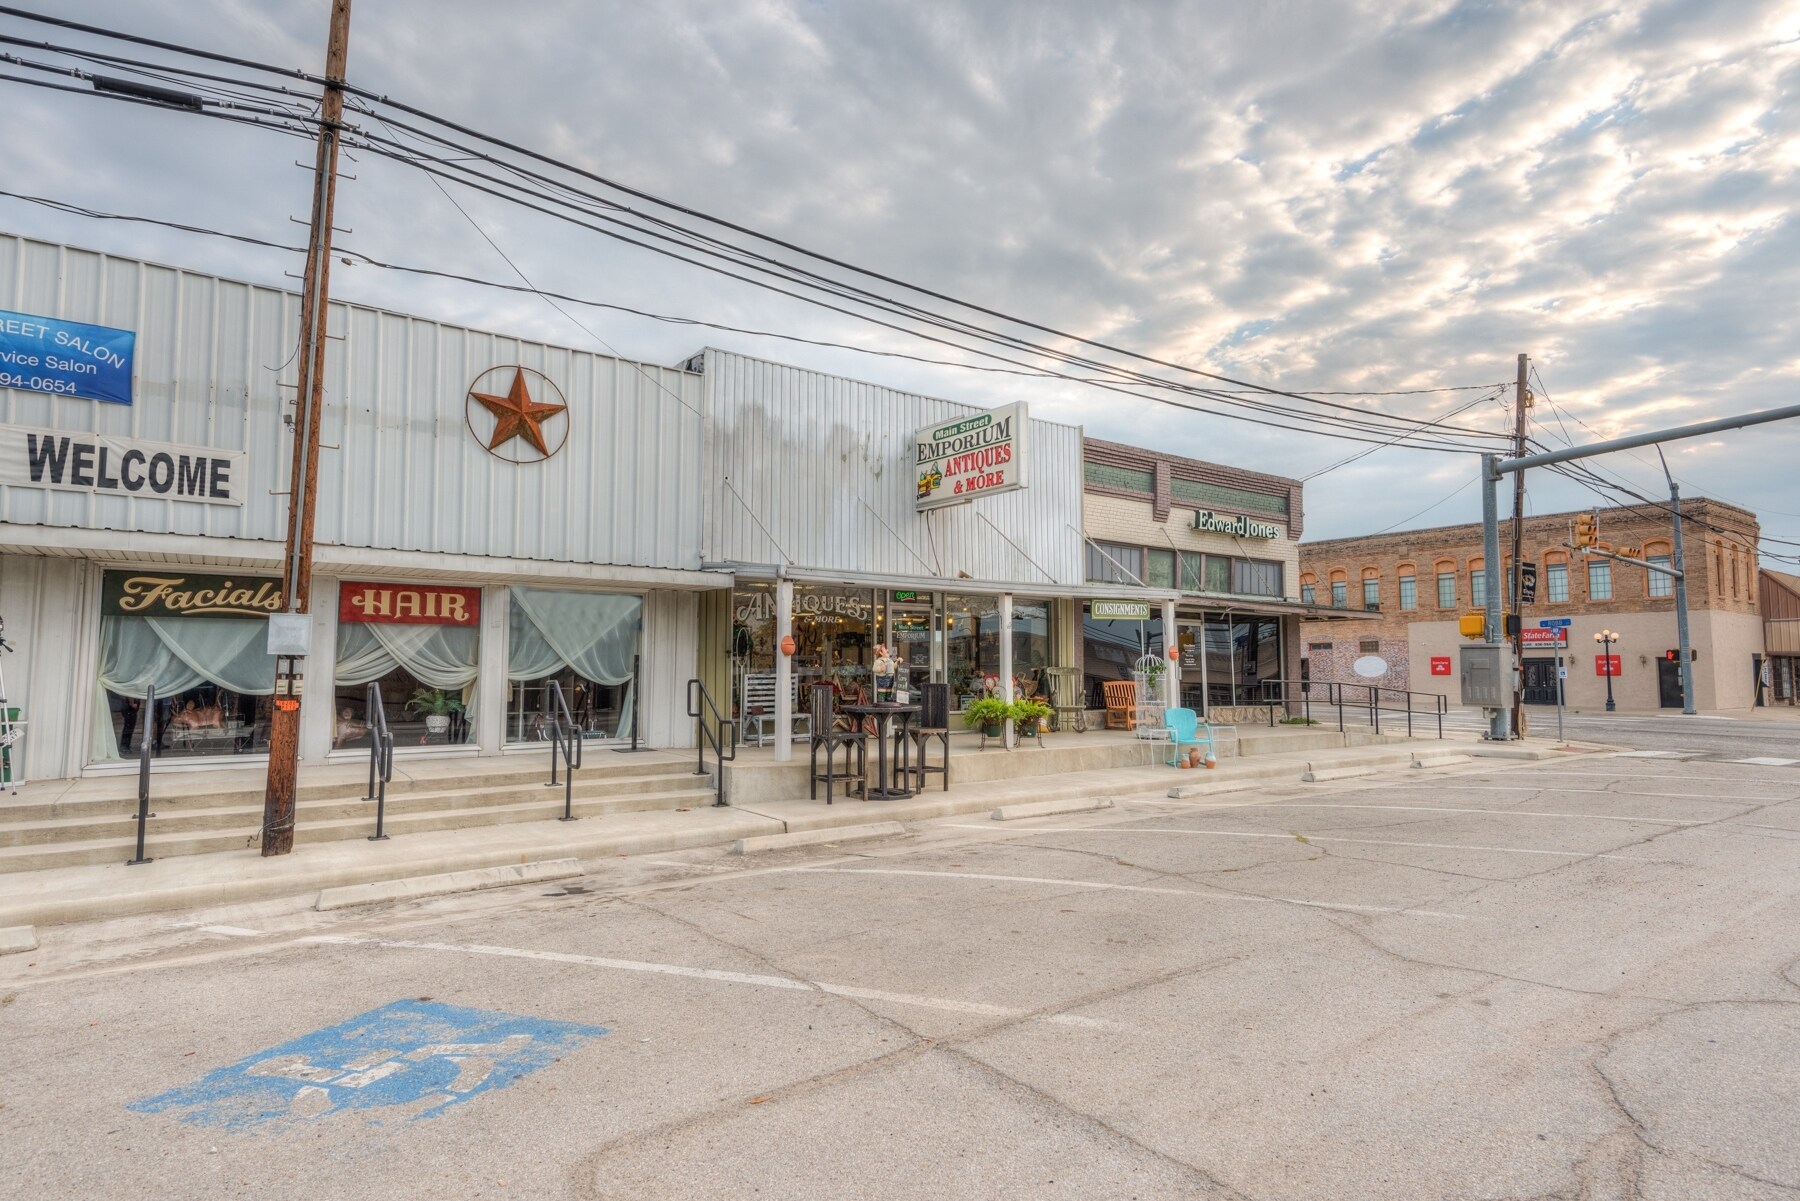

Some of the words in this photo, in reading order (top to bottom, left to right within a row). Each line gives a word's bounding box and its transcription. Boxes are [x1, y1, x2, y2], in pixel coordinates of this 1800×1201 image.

[0, 350, 39, 366] vice
[45, 355, 97, 375] Salon
[55, 331, 125, 369] SALON
[917, 416, 1012, 462] EMPORIUM
[935, 426, 958, 440] Main
[960, 416, 989, 432] Street
[27, 434, 231, 499] WELCOME
[944, 443, 1012, 478] ANTIQUES
[954, 480, 963, 495] &
[966, 470, 1004, 492] MORE
[1198, 509, 1245, 535] Edward
[1244, 516, 1280, 539] Jones
[119, 576, 282, 611] Facials
[351, 589, 470, 622] HAIR
[736, 592, 868, 620] ANIQUES
[813, 615, 840, 624] MORE
[1095, 602, 1148, 616] CONSIGNMENTS
